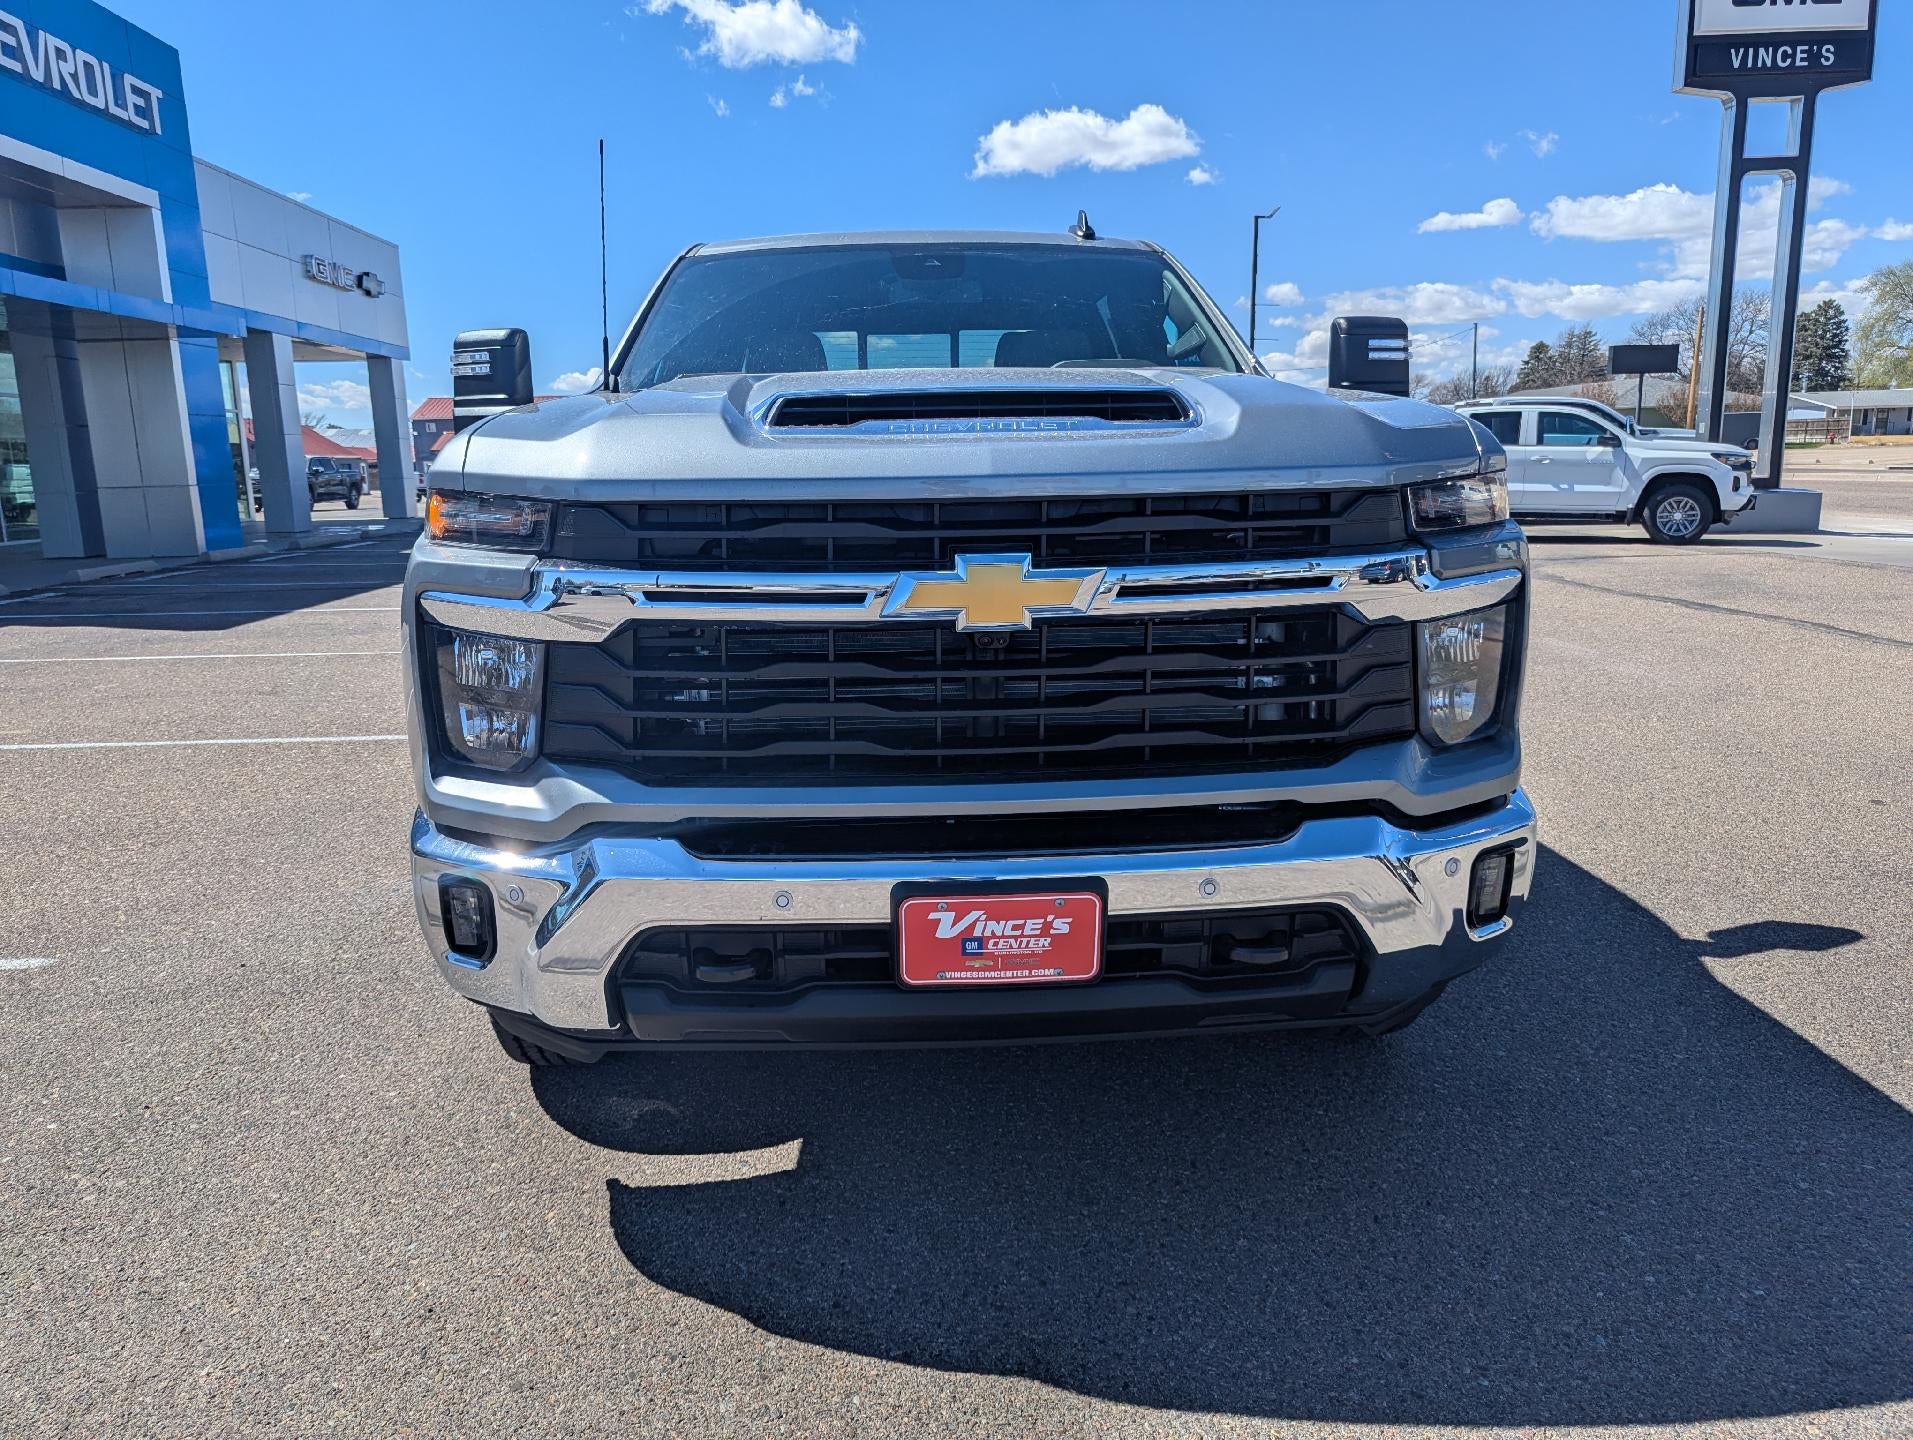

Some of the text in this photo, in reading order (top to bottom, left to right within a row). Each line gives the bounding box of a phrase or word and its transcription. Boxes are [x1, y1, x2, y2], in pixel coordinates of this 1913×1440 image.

[1730, 44, 1836, 69] VINCE'S
[306, 255, 355, 292] GMC
[887, 419, 1079, 433] CHEVROLET
[965, 937, 1052, 950] GM CENTER
[945, 968, 1055, 979] VINCESGMCENTER.COM
